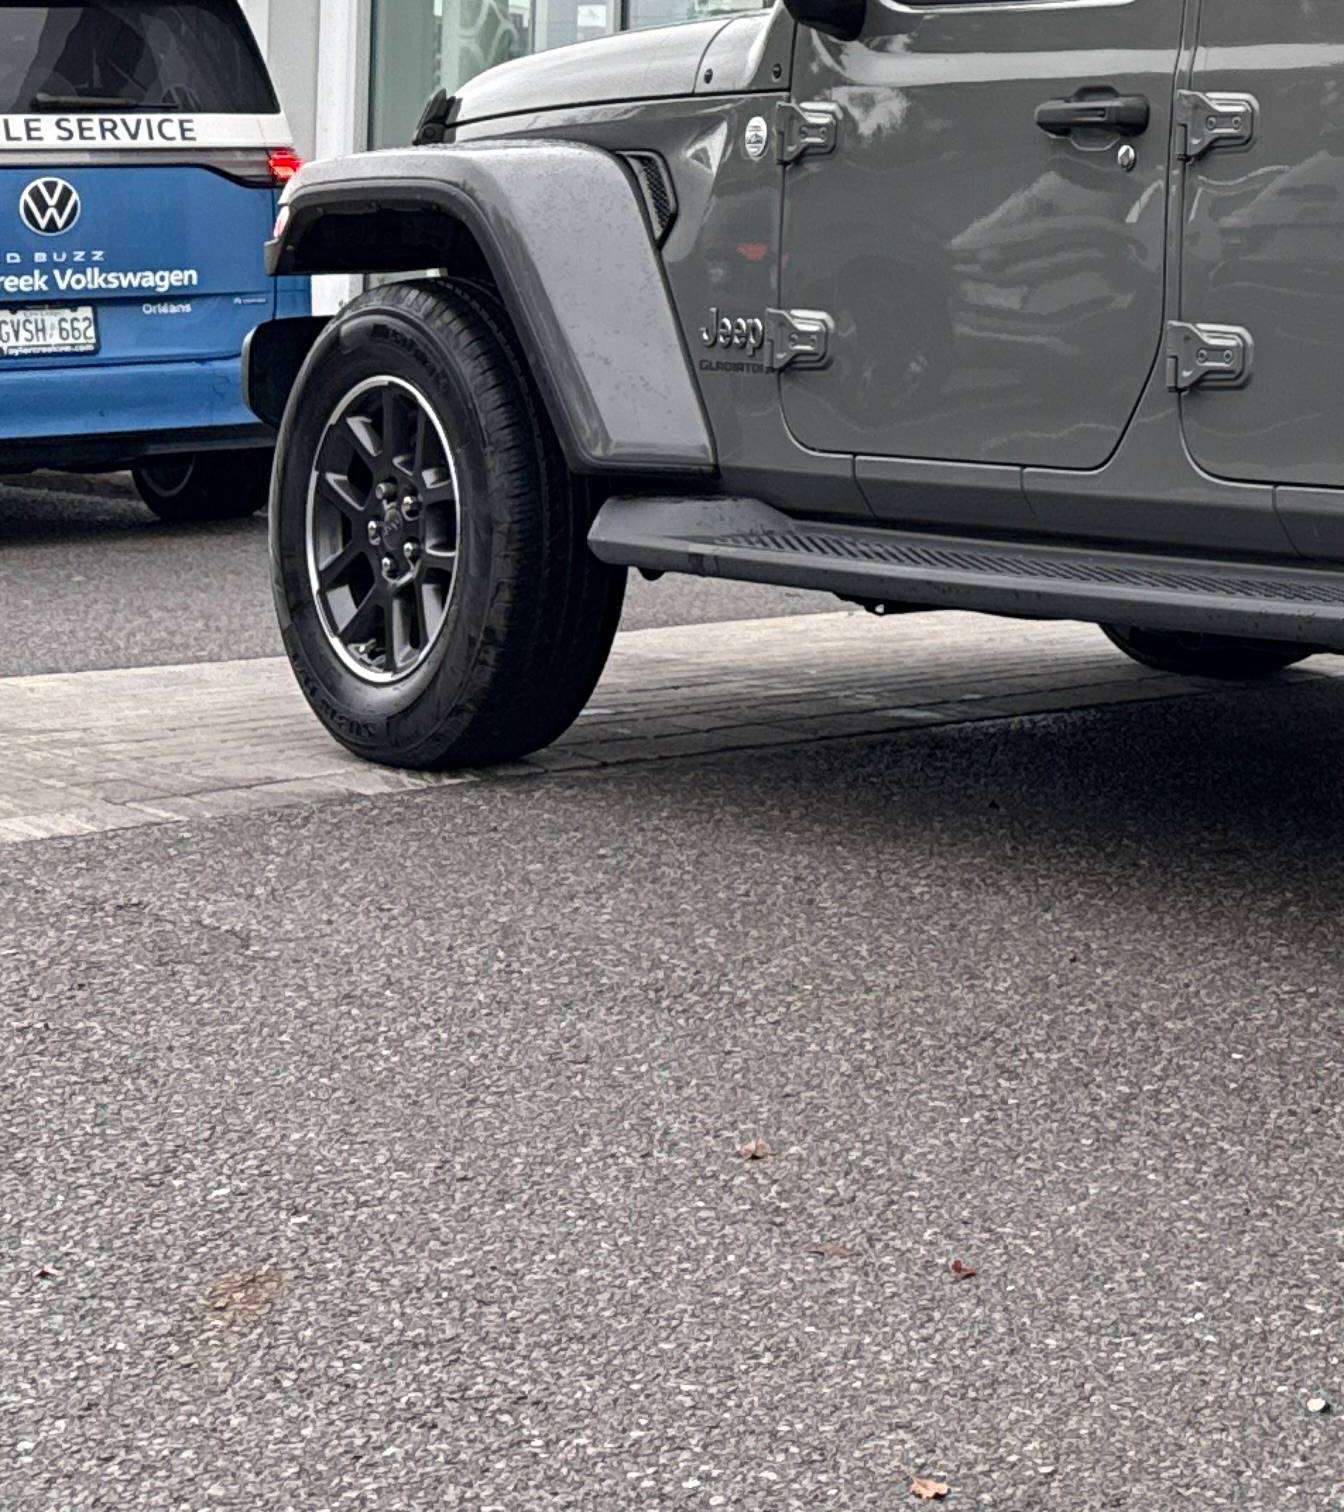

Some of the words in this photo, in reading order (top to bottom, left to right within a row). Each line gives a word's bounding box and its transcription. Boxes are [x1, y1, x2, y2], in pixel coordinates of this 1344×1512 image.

[3, 118, 44, 141] LE
[55, 118, 196, 141] SERVICE
[19, 177, 81, 237] VW
[34, 250, 105, 263] BUZZ
[53, 268, 197, 292] Volkswagen
[58, 316, 94, 341] 662
[700, 307, 763, 357] Jeep
[700, 360, 765, 374] GLADIATO
